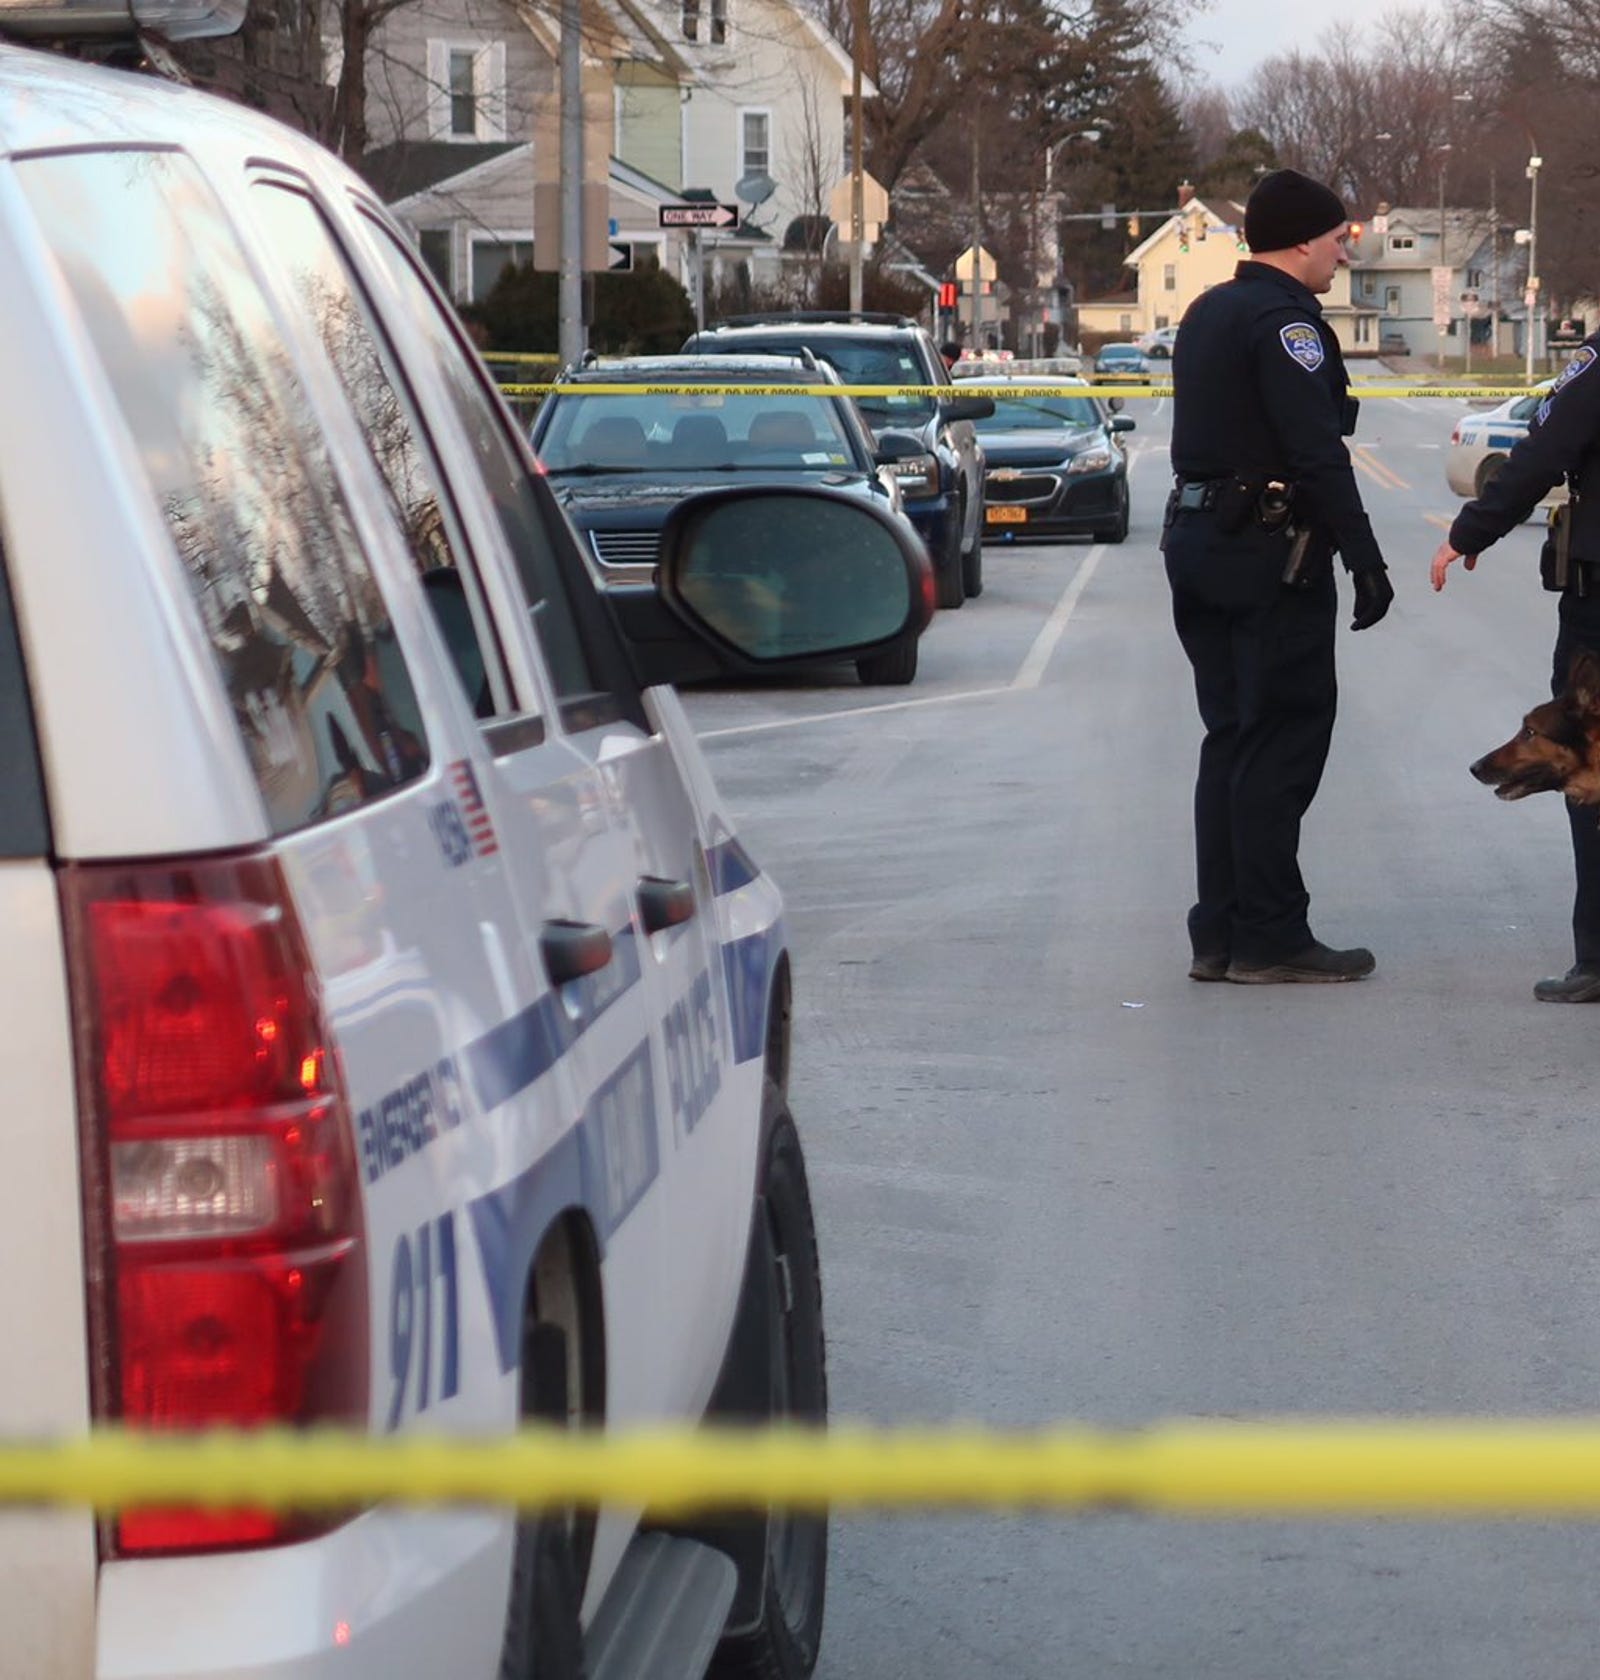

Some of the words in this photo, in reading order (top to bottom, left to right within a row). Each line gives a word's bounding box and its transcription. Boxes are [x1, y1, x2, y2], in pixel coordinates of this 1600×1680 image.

[665, 211, 685, 221] ONE
[691, 211, 713, 221] WAY
[1461, 432, 1477, 447] 911
[427, 800, 473, 868] USA
[386, 1209, 461, 1434] 911
